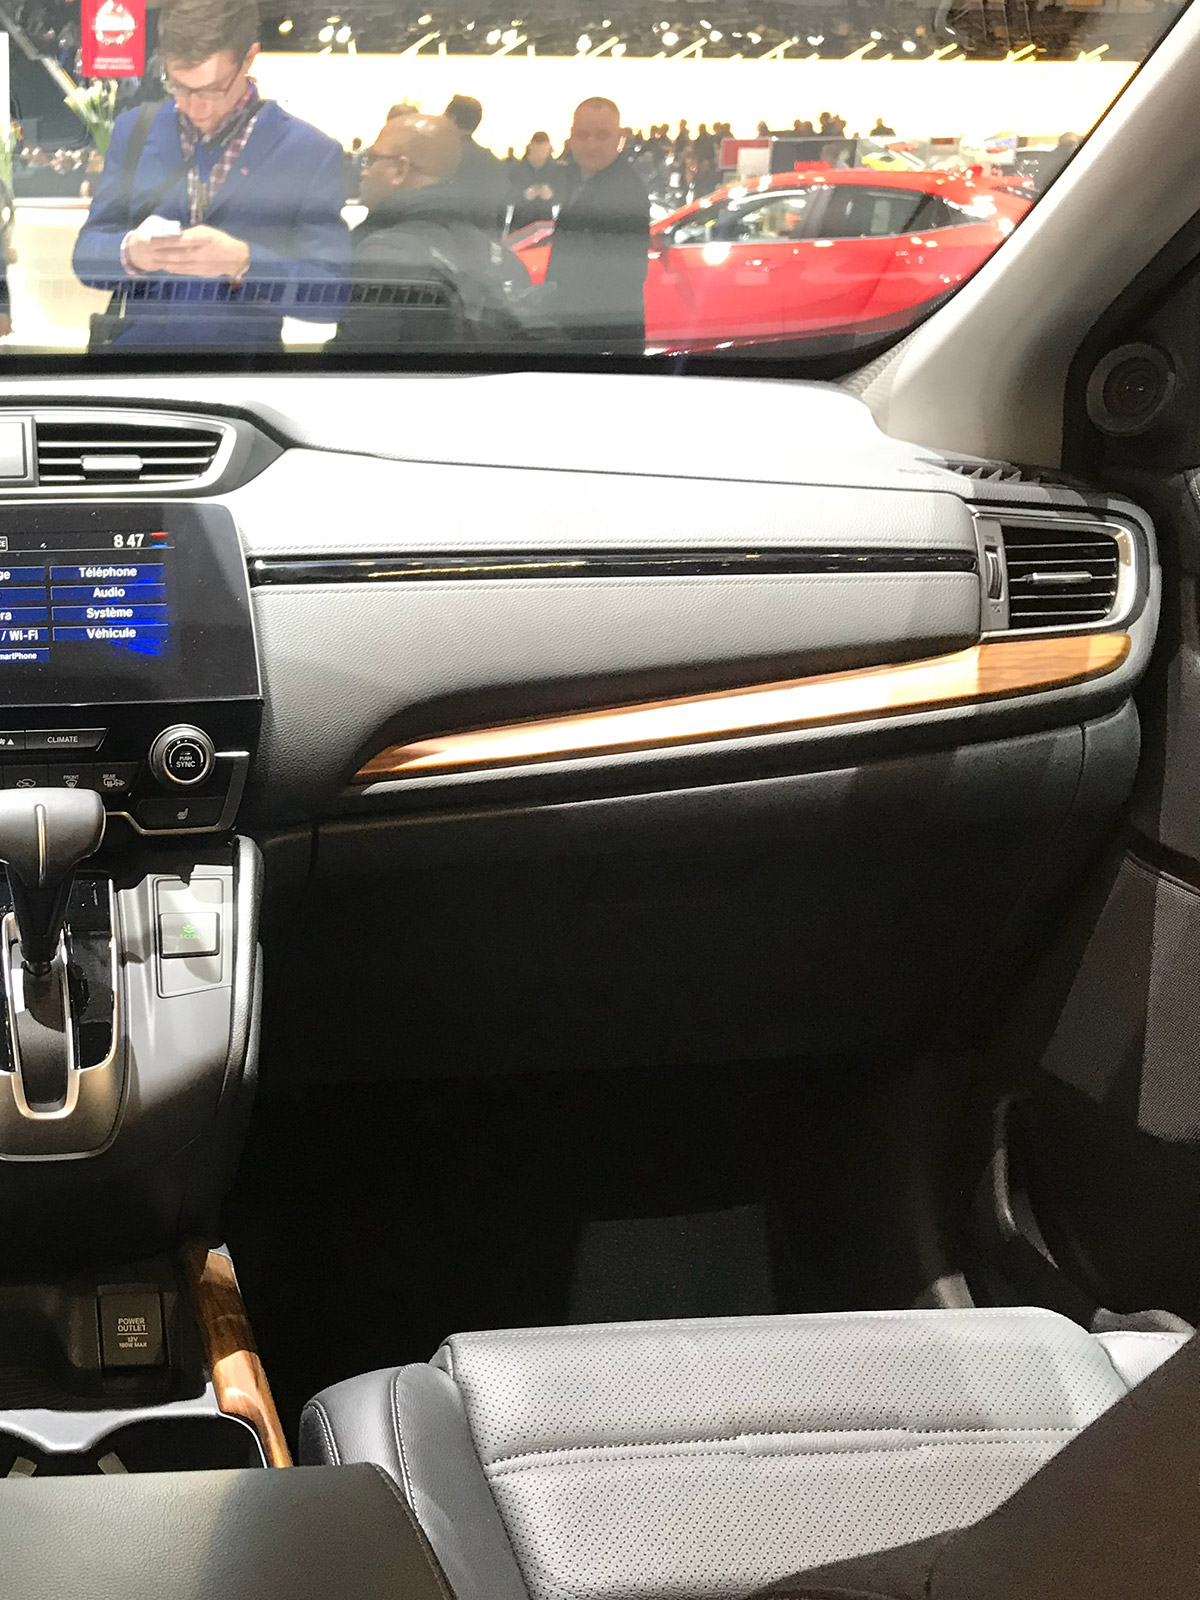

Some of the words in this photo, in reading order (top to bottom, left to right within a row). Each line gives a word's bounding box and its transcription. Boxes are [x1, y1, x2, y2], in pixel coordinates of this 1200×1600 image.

[79, 567, 138, 578] Téléphone
[93, 587, 126, 598] Audio
[86, 608, 134, 619] Système
[0, 631, 6, 641] /
[9, 630, 39, 641] Wi-Fi
[86, 628, 137, 639] Véhicule
[118, 1317, 145, 1325] POWER
[117, 1324, 146, 1332] OUTLET
